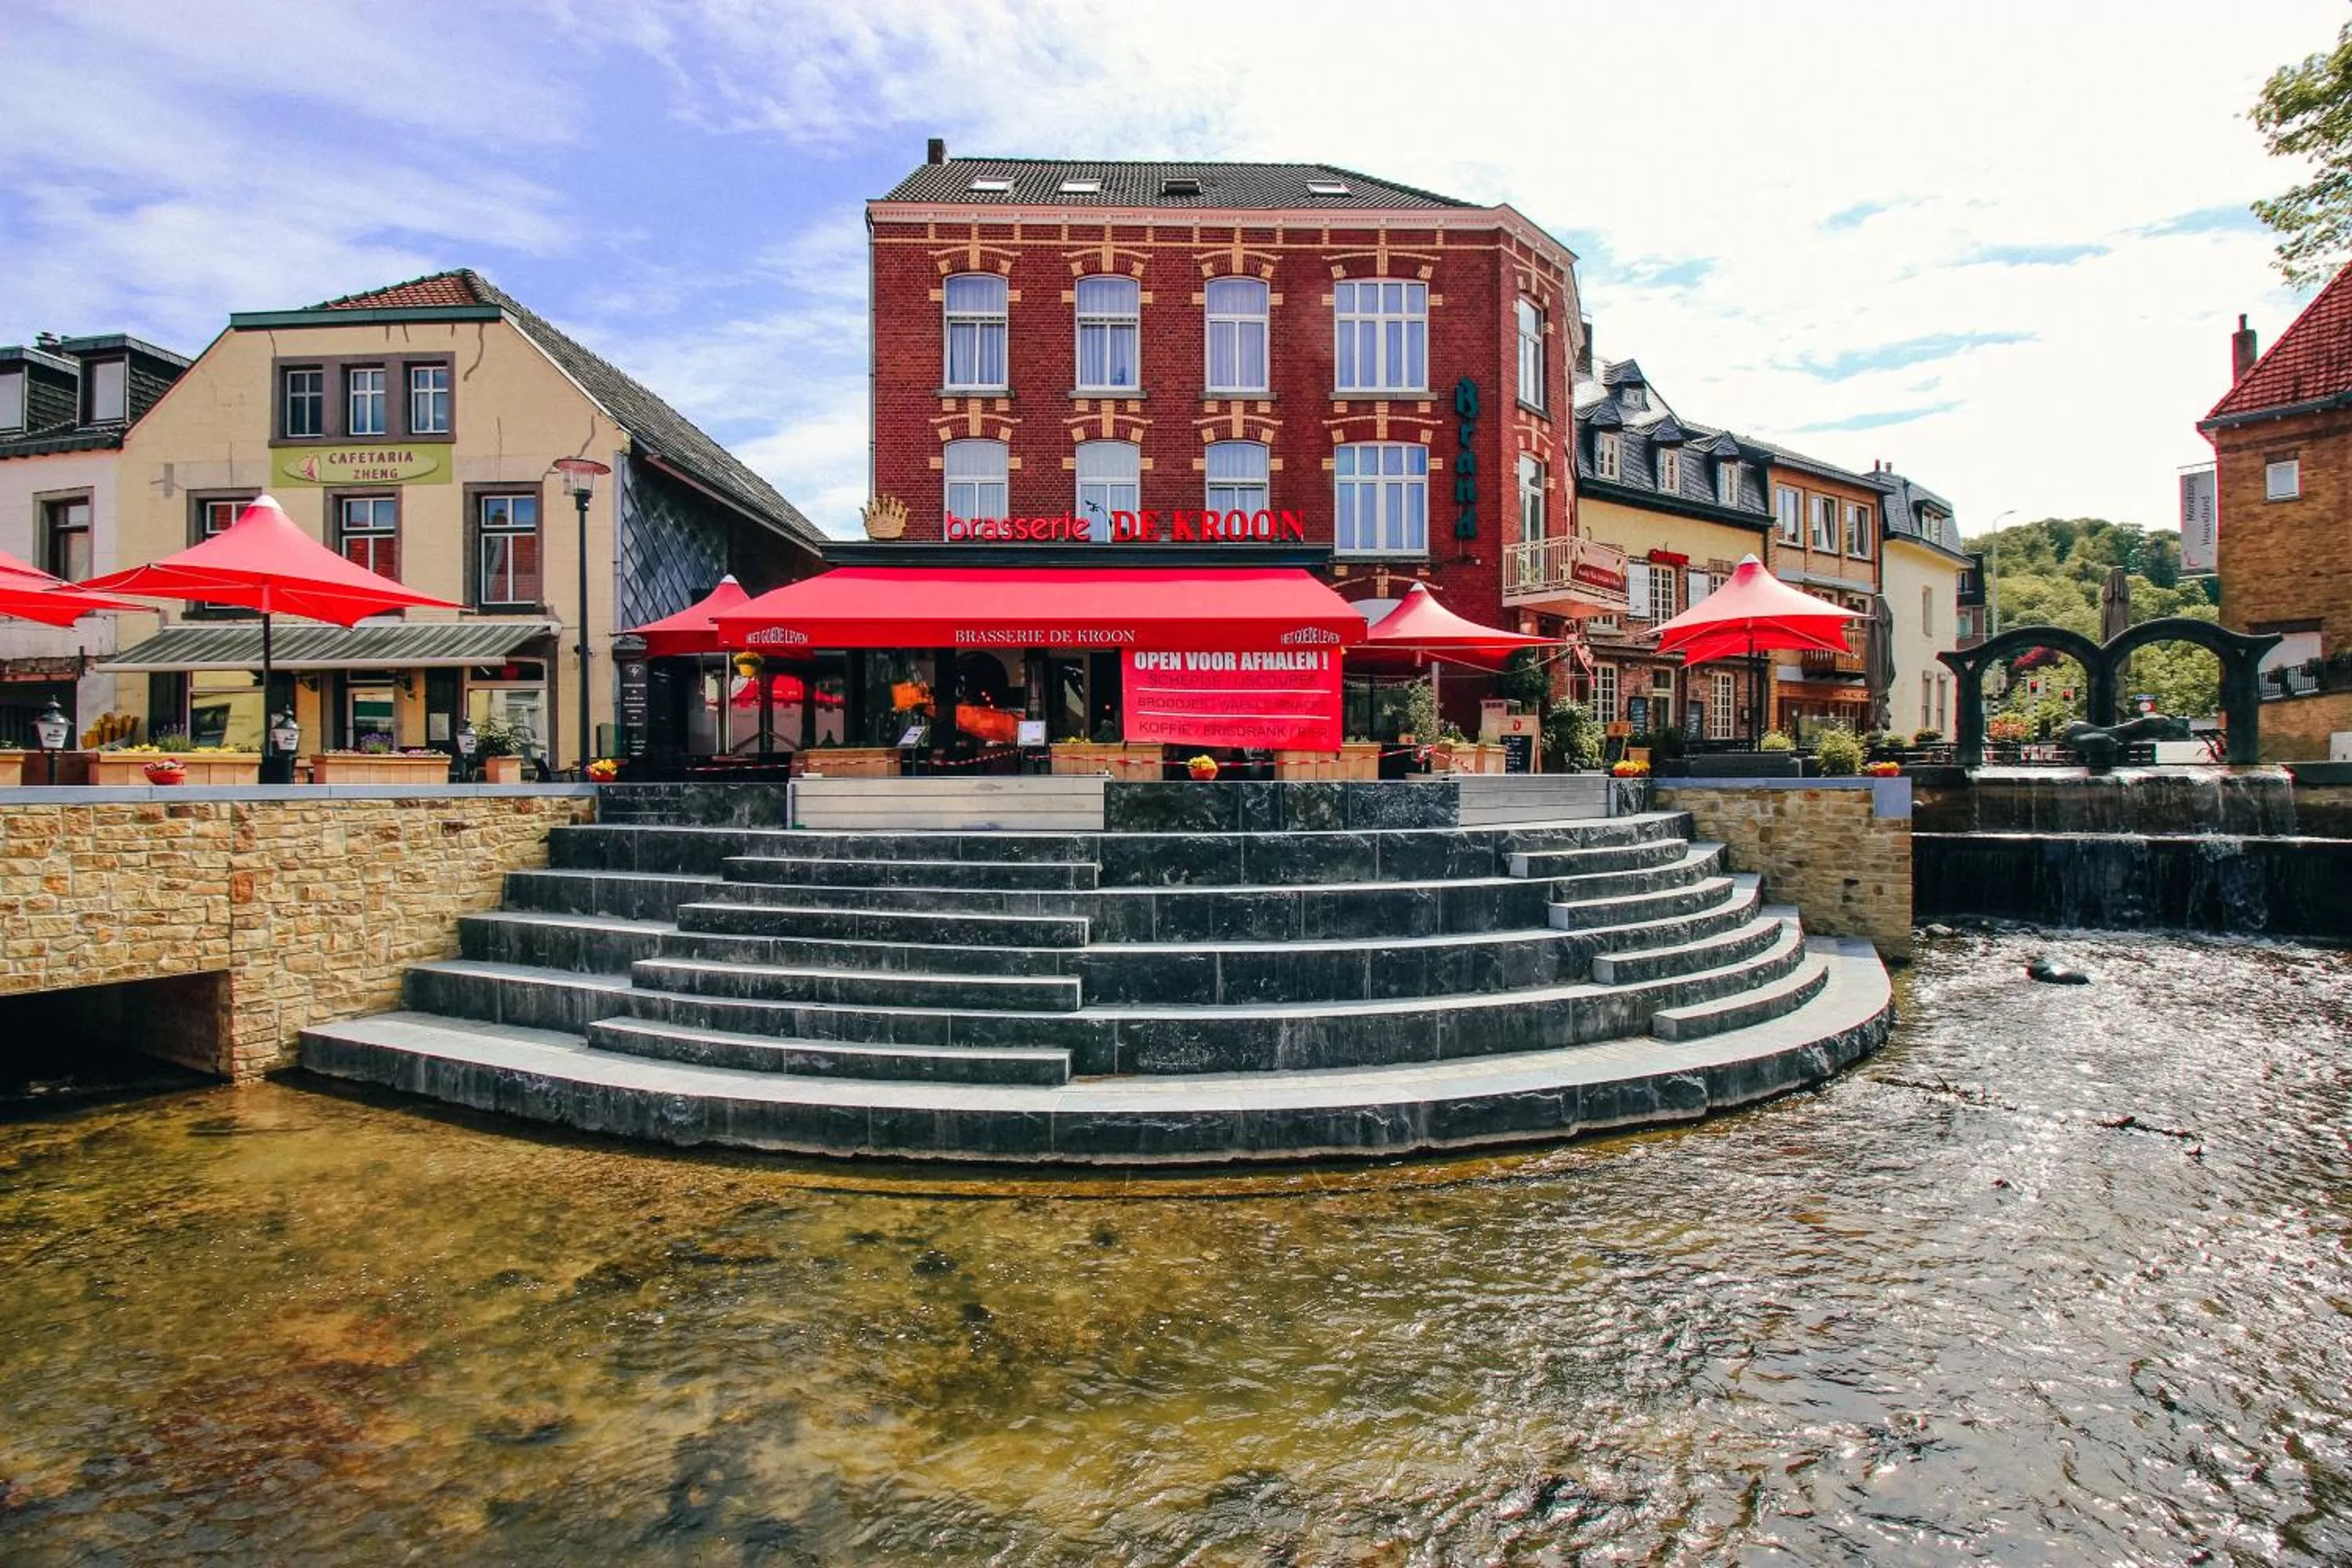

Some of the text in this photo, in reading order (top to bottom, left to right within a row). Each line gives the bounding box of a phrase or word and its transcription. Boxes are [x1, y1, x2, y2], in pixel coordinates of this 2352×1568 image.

[328, 451, 413, 464] CAFETARIA
[1455, 376, 1479, 539] Brand
[353, 468, 398, 480] ZHENG
[946, 510, 1305, 543] brasserie DE KROON
[746, 626, 808, 645] HET GOEDE LEVEN
[955, 630, 1135, 643] BRASSERIE DE KROON
[1280, 627, 1341, 644] HET GOEDE LEVEN
[1134, 652, 1181, 670] OPEN
[1185, 652, 1236, 670] VOOR
[1240, 652, 1318, 670] AFHALEN
[1139, 720, 1192, 735] KOFFIE
[1203, 723, 1286, 737] FRISDRANK
